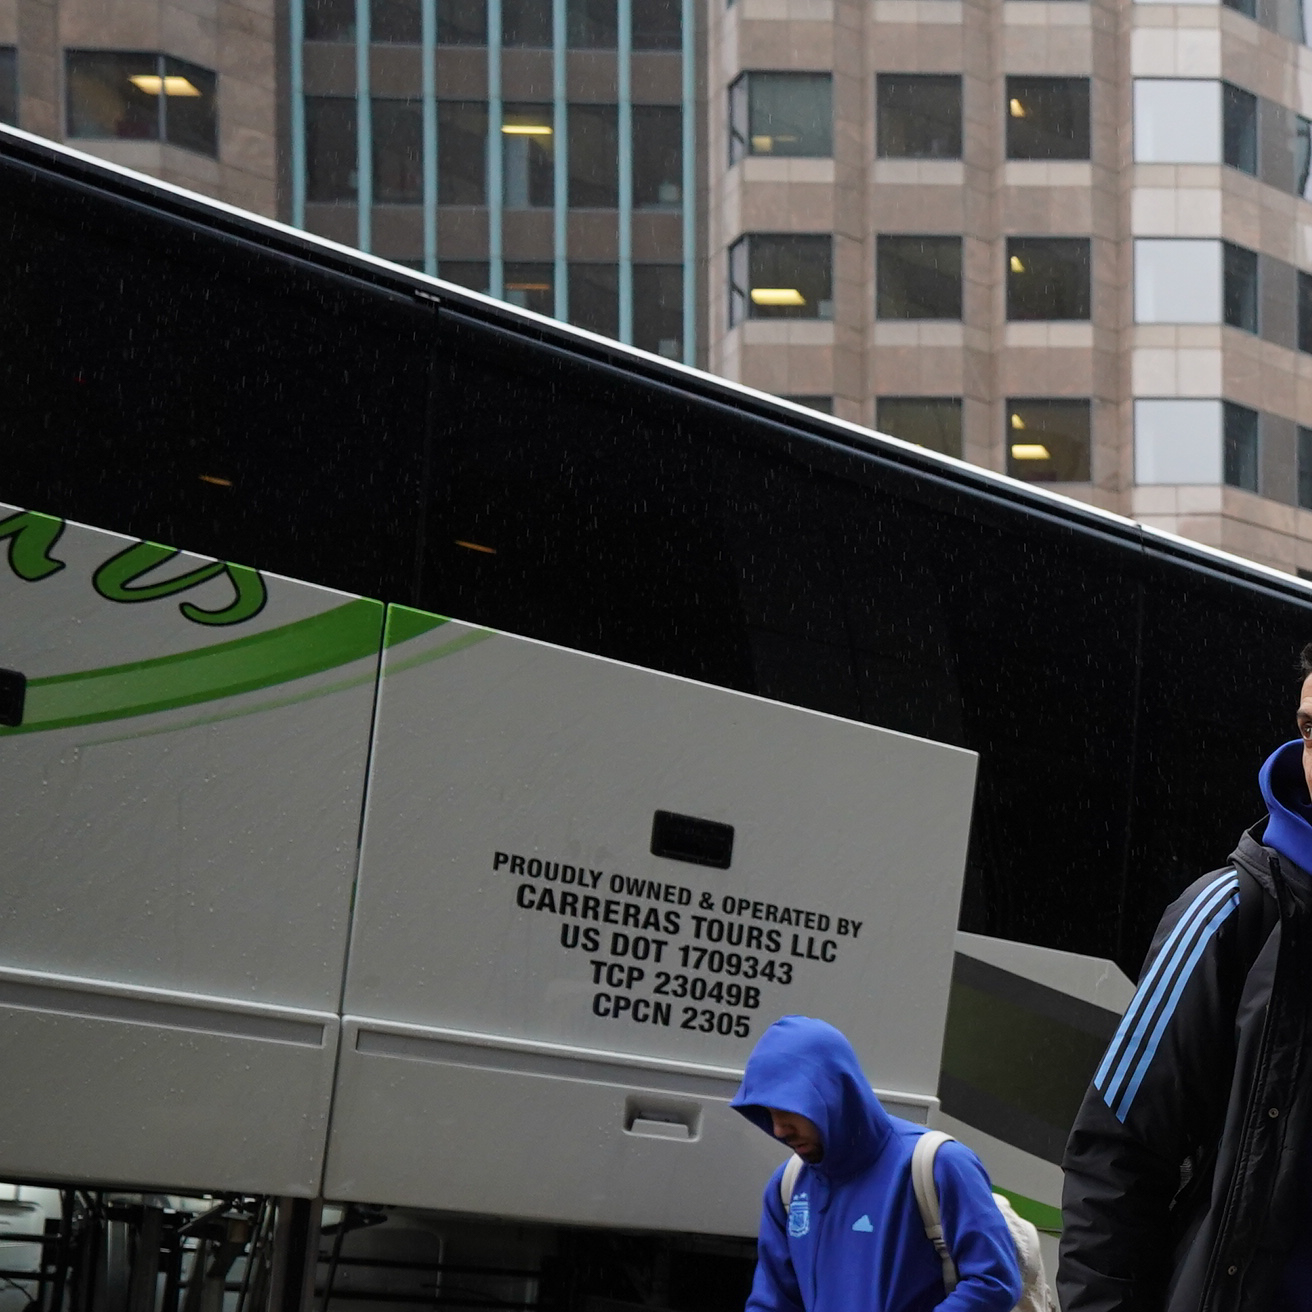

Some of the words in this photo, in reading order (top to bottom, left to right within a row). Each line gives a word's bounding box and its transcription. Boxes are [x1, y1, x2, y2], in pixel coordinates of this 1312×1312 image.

[492, 851, 602, 890] PROUDLY
[610, 874, 691, 906] OWNED
[699, 891, 715, 910] &
[722, 896, 829, 932] OPERATED
[836, 915, 863, 938] BY
[516, 883, 680, 934] CARRERAS
[692, 915, 781, 953] TOURS
[791, 935, 837, 963] LLC
[560, 923, 600, 952] US
[610, 932, 668, 964] DOT
[679, 945, 793, 985] 1709343
[590, 960, 644, 990] TCP
[653, 972, 761, 1009] 23049B
[592, 992, 671, 1026] CPCN
[680, 1007, 750, 1038] 2305
